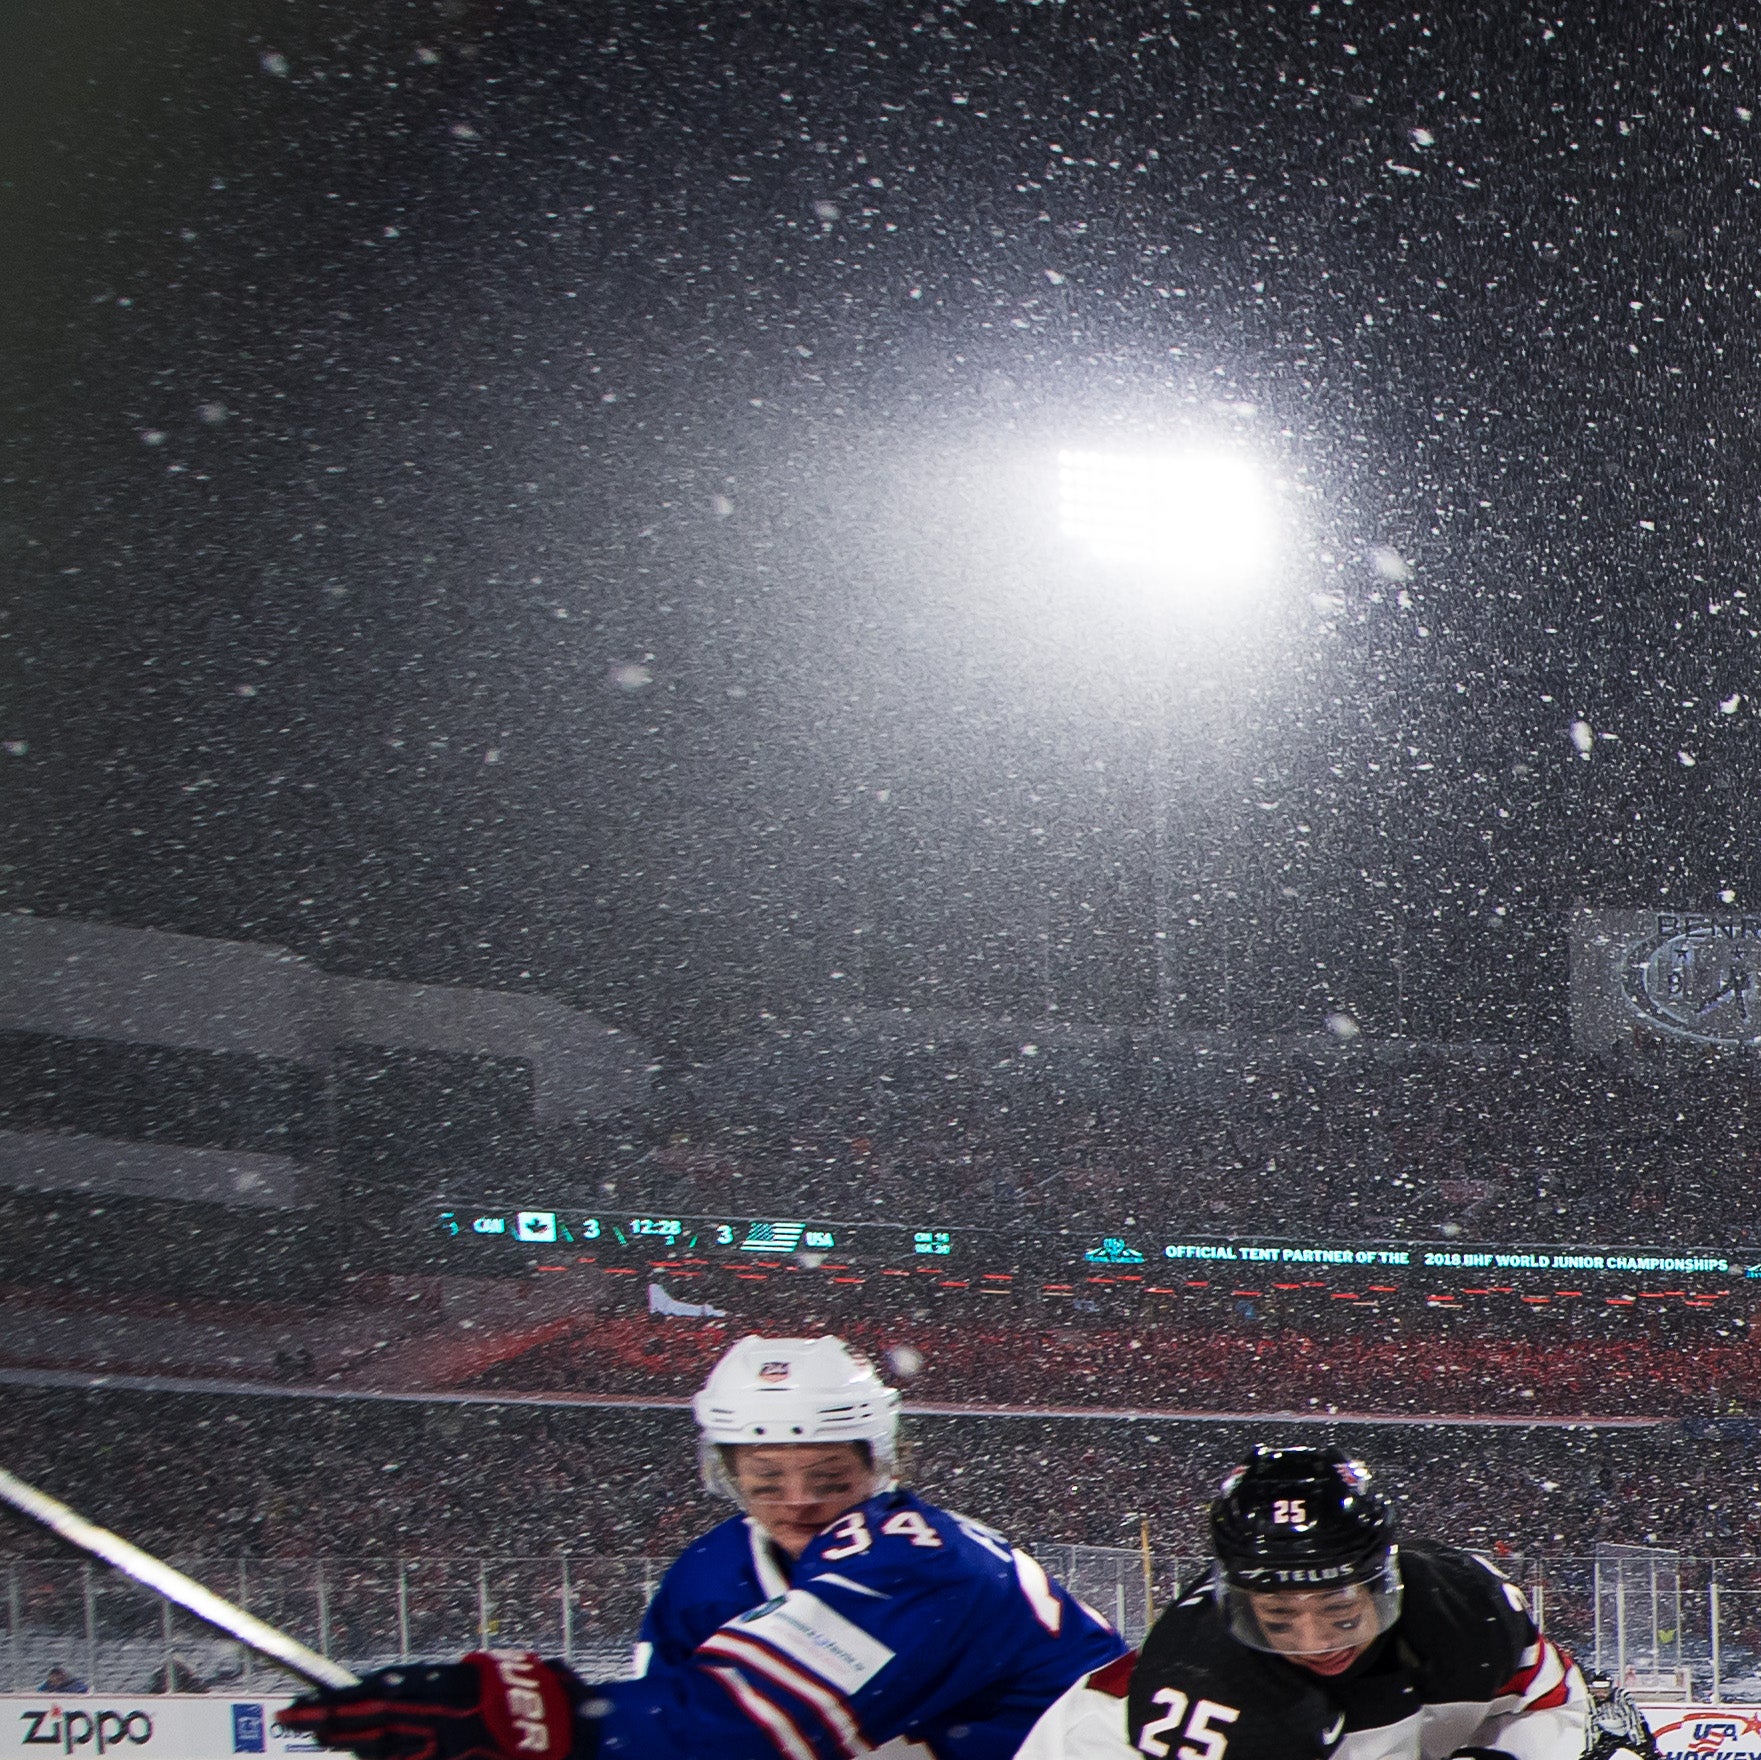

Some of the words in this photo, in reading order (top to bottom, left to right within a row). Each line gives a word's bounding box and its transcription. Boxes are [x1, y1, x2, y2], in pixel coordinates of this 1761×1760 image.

[473, 1218, 506, 1235] CAN
[583, 1218, 601, 1239] 3
[717, 1225, 733, 1245] 3
[805, 1230, 834, 1248] USA
[1166, 1245, 1237, 1260] OFFICIAL
[1239, 1247, 1281, 1261] TENT
[1283, 1249, 1354, 1263] PARTNER
[1356, 1251, 1377, 1264] OF
[1379, 1251, 1409, 1265] THE
[1425, 1252, 1461, 1266] 2018
[1496, 1254, 1549, 1268] WORLD
[1551, 1255, 1604, 1270] JUNIOR
[1606, 1256, 1728, 1273] CHAMPIONSHIPS
[1272, 1499, 1306, 1524] 25
[818, 1509, 946, 1562] 34
[1279, 1561, 1356, 1583] TELUS
[496, 1648, 551, 1753] UER
[1690, 1723, 1738, 1749] USA
